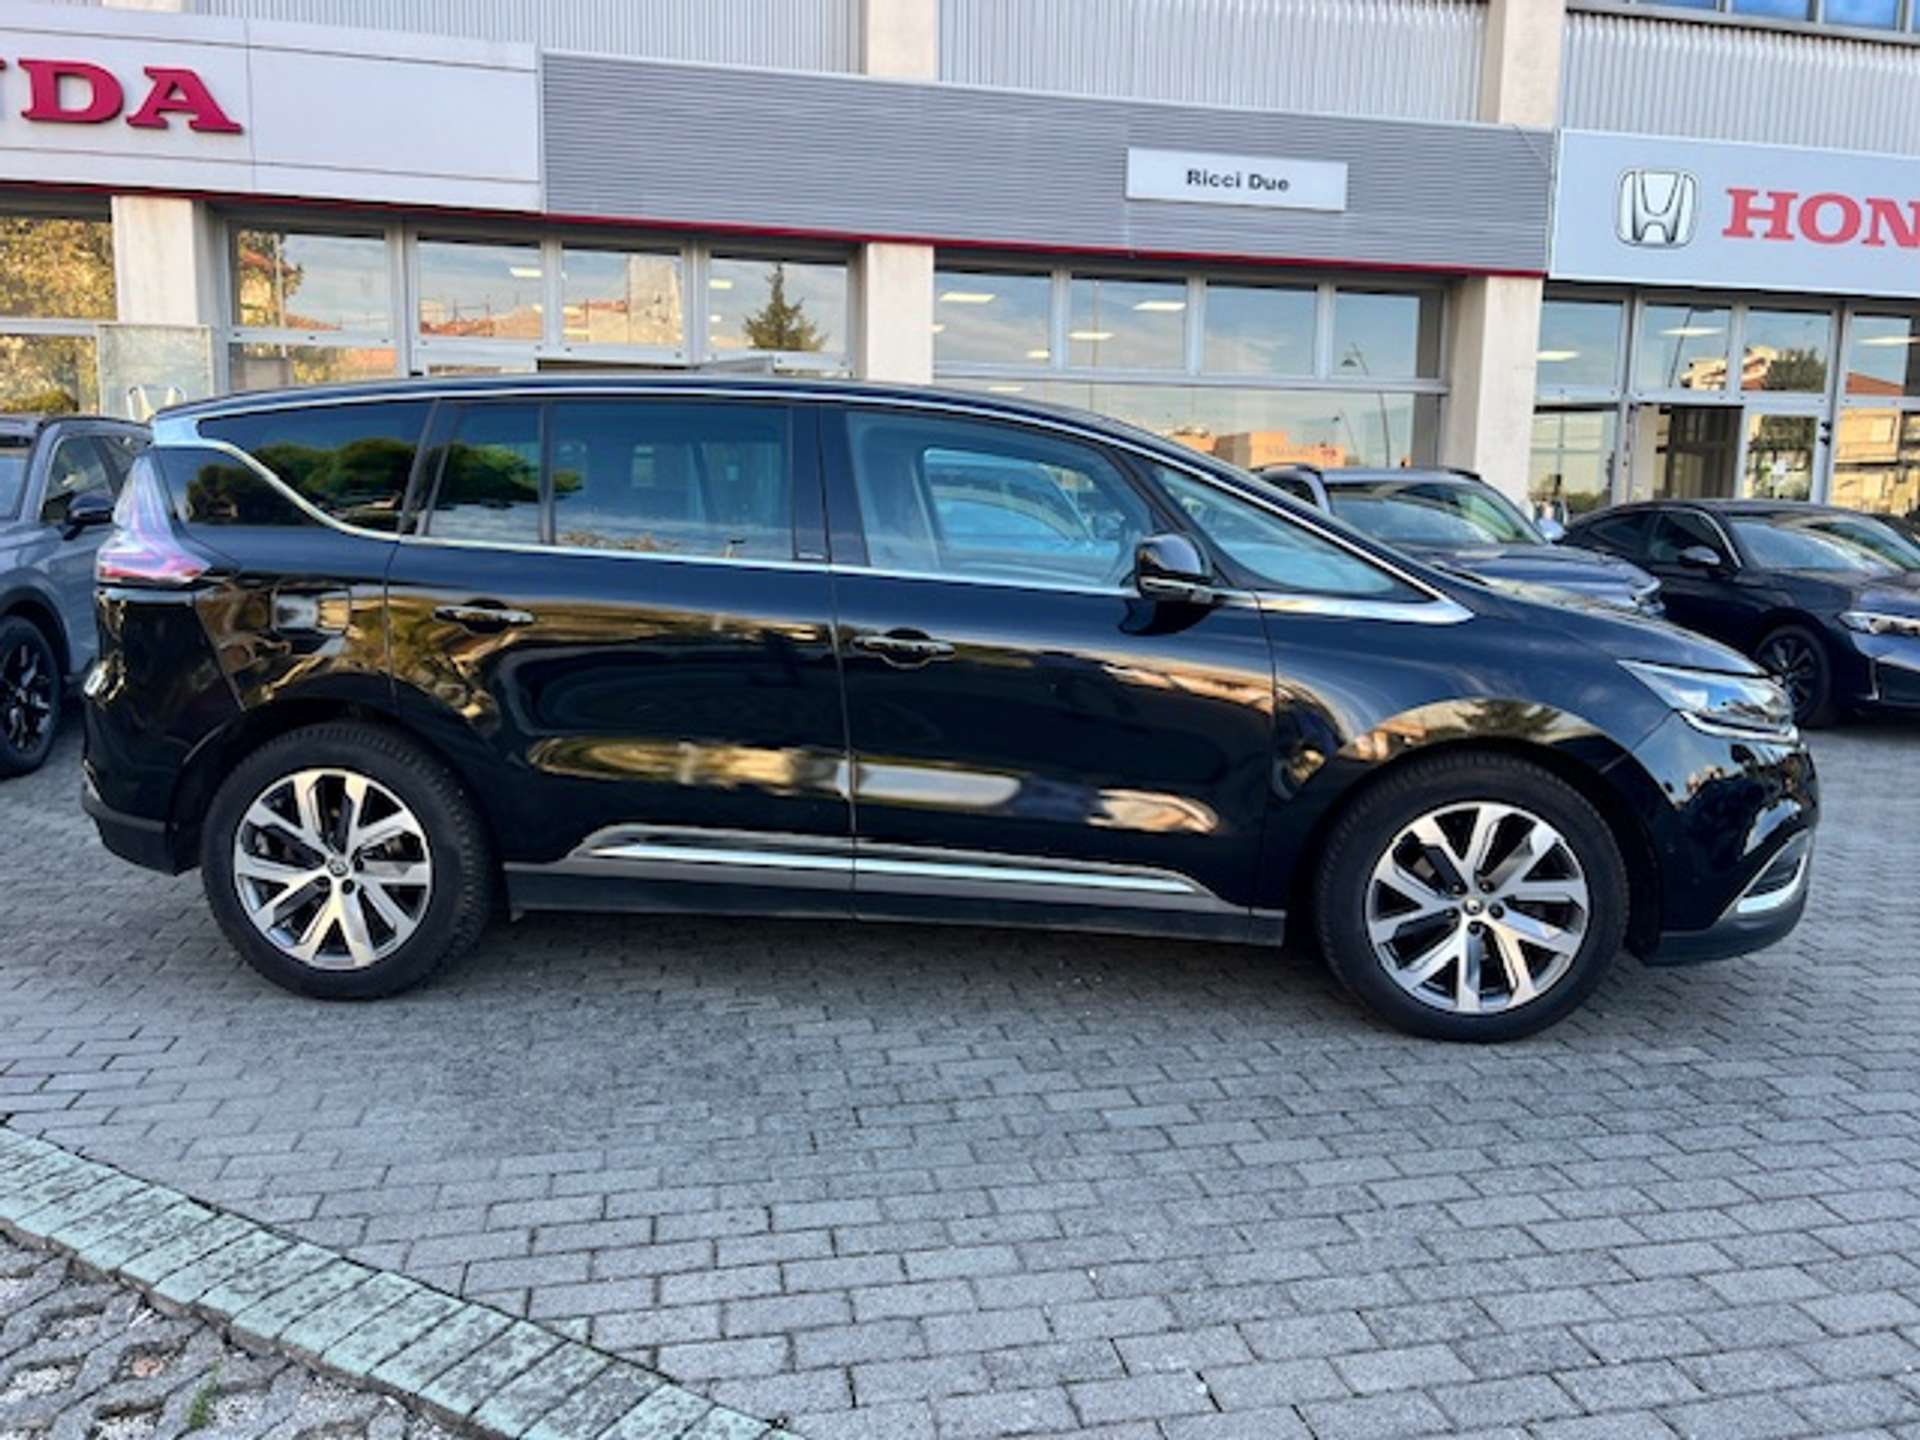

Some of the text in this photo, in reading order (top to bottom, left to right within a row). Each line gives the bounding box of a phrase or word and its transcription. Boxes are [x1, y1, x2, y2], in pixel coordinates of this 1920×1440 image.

[0, 57, 244, 135] DA
[1187, 169, 1290, 192] Ricci Due
[1722, 187, 1920, 248] HON
